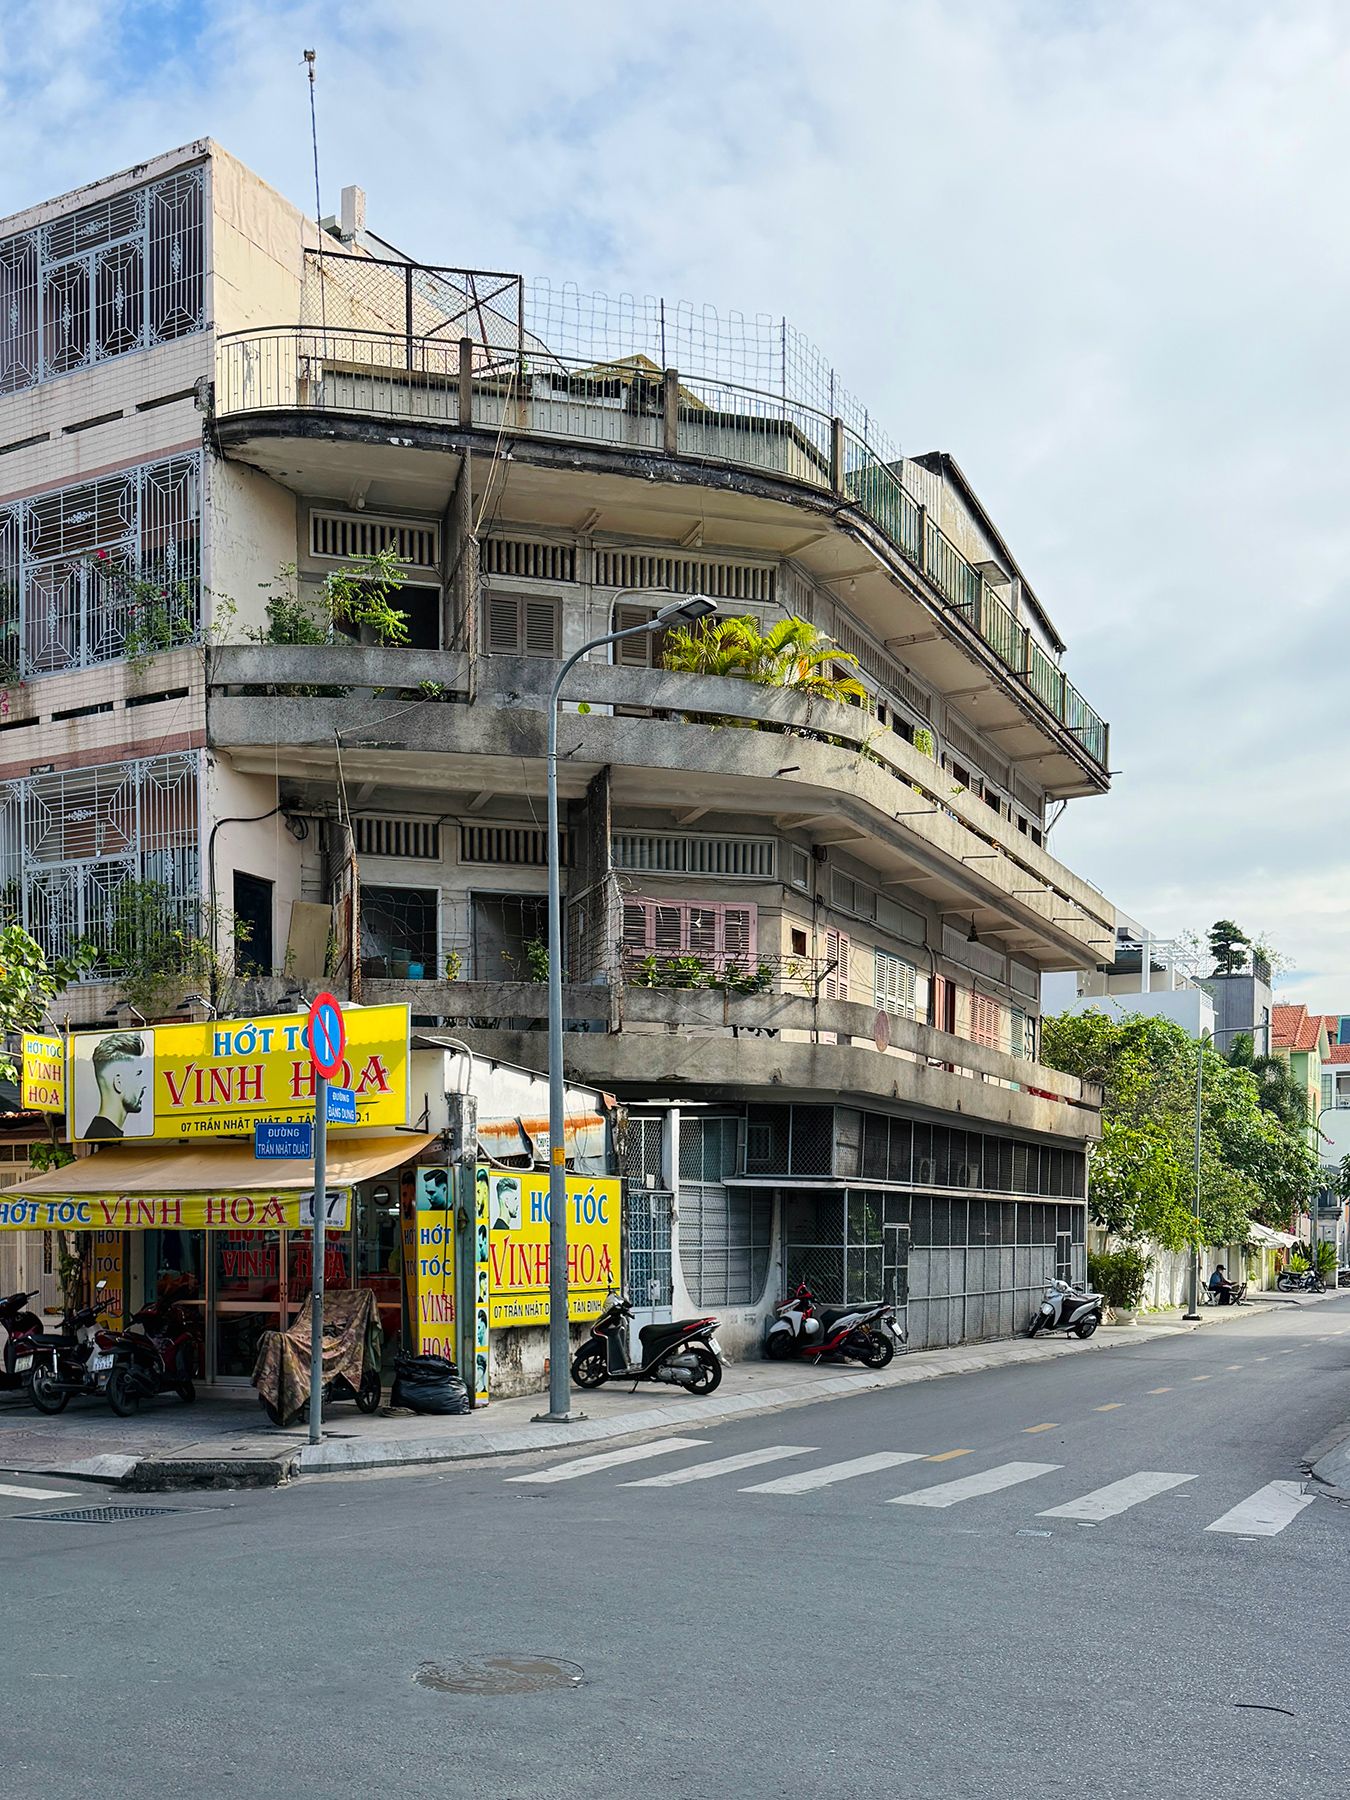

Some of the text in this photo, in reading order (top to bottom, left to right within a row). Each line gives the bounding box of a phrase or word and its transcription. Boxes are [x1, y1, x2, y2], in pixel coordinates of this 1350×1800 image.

[214, 1023, 274, 1056] HỚT
[28, 1060, 62, 1081] VINH
[162, 1063, 266, 1106] VINH
[29, 1086, 60, 1105] HOA
[181, 1122, 192, 1133] 07
[268, 1126, 300, 1138] ĐƯỜNG
[46, 1197, 91, 1223] TÓC
[100, 1195, 184, 1226] VINH
[204, 1196, 288, 1226] HOA
[574, 1186, 609, 1224] TÓC
[420, 1224, 452, 1245] HỚT
[97, 1253, 120, 1272] TÓC
[420, 1255, 452, 1276] TÓC
[490, 1236, 550, 1286] VINH
[421, 1290, 454, 1322] VINH
[494, 1305, 502, 1318] 07
